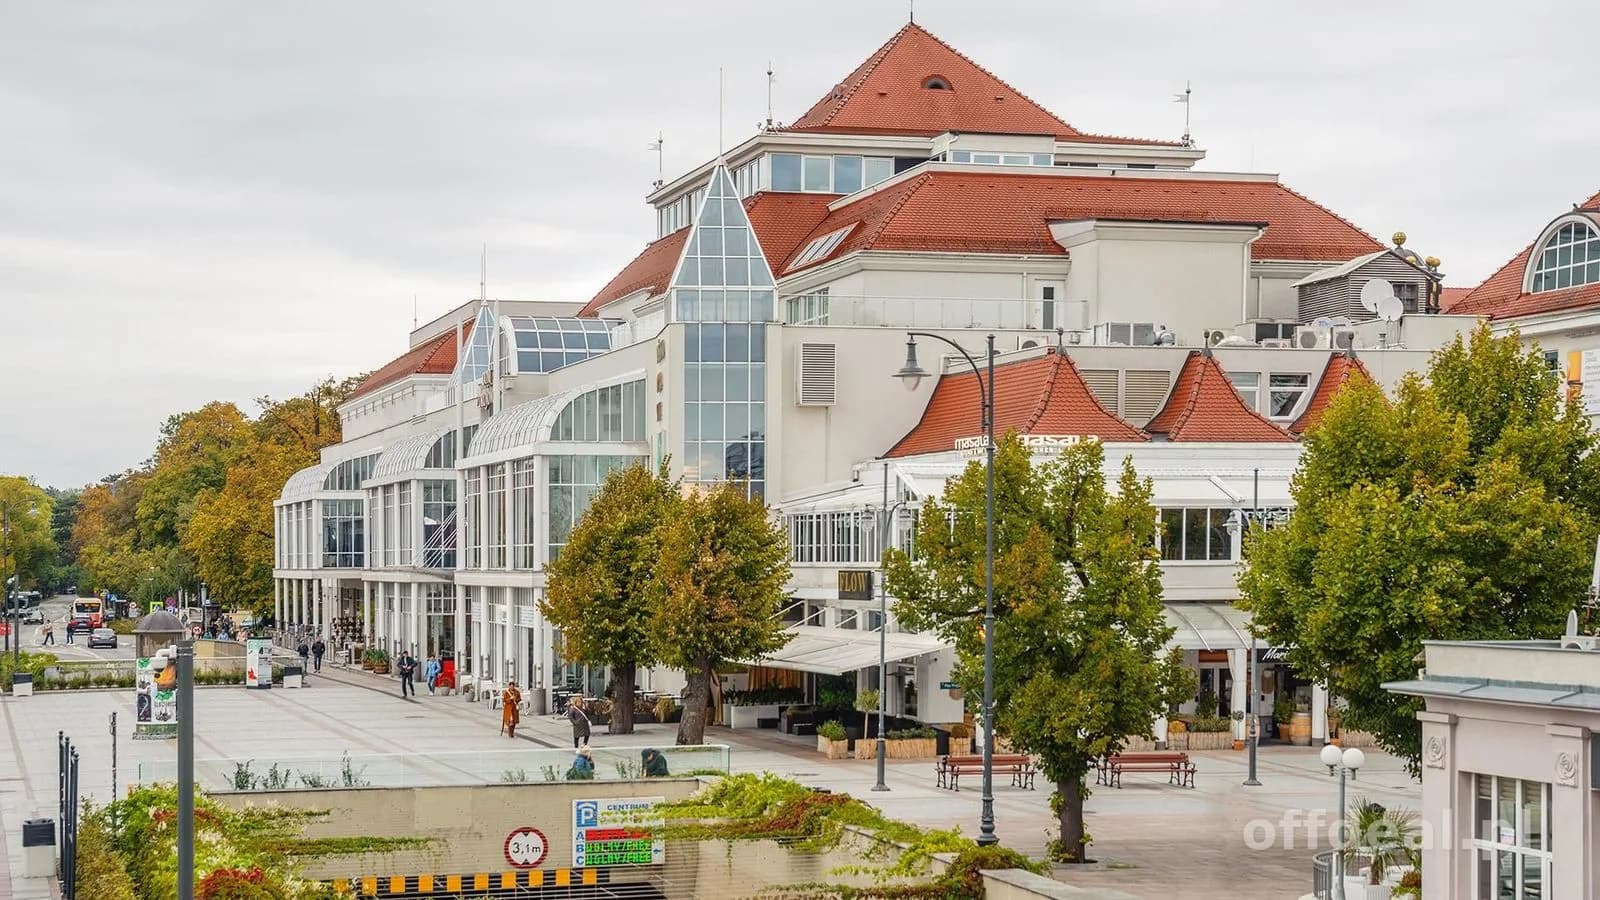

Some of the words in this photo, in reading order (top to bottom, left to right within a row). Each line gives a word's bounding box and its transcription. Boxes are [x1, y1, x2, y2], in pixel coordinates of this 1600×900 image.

[954, 435, 989, 450] masala
[840, 572, 868, 593] FLOW
[606, 803, 649, 812] CENTRUM
[575, 831, 585, 841] A
[575, 844, 585, 853] B
[575, 855, 585, 865] C
